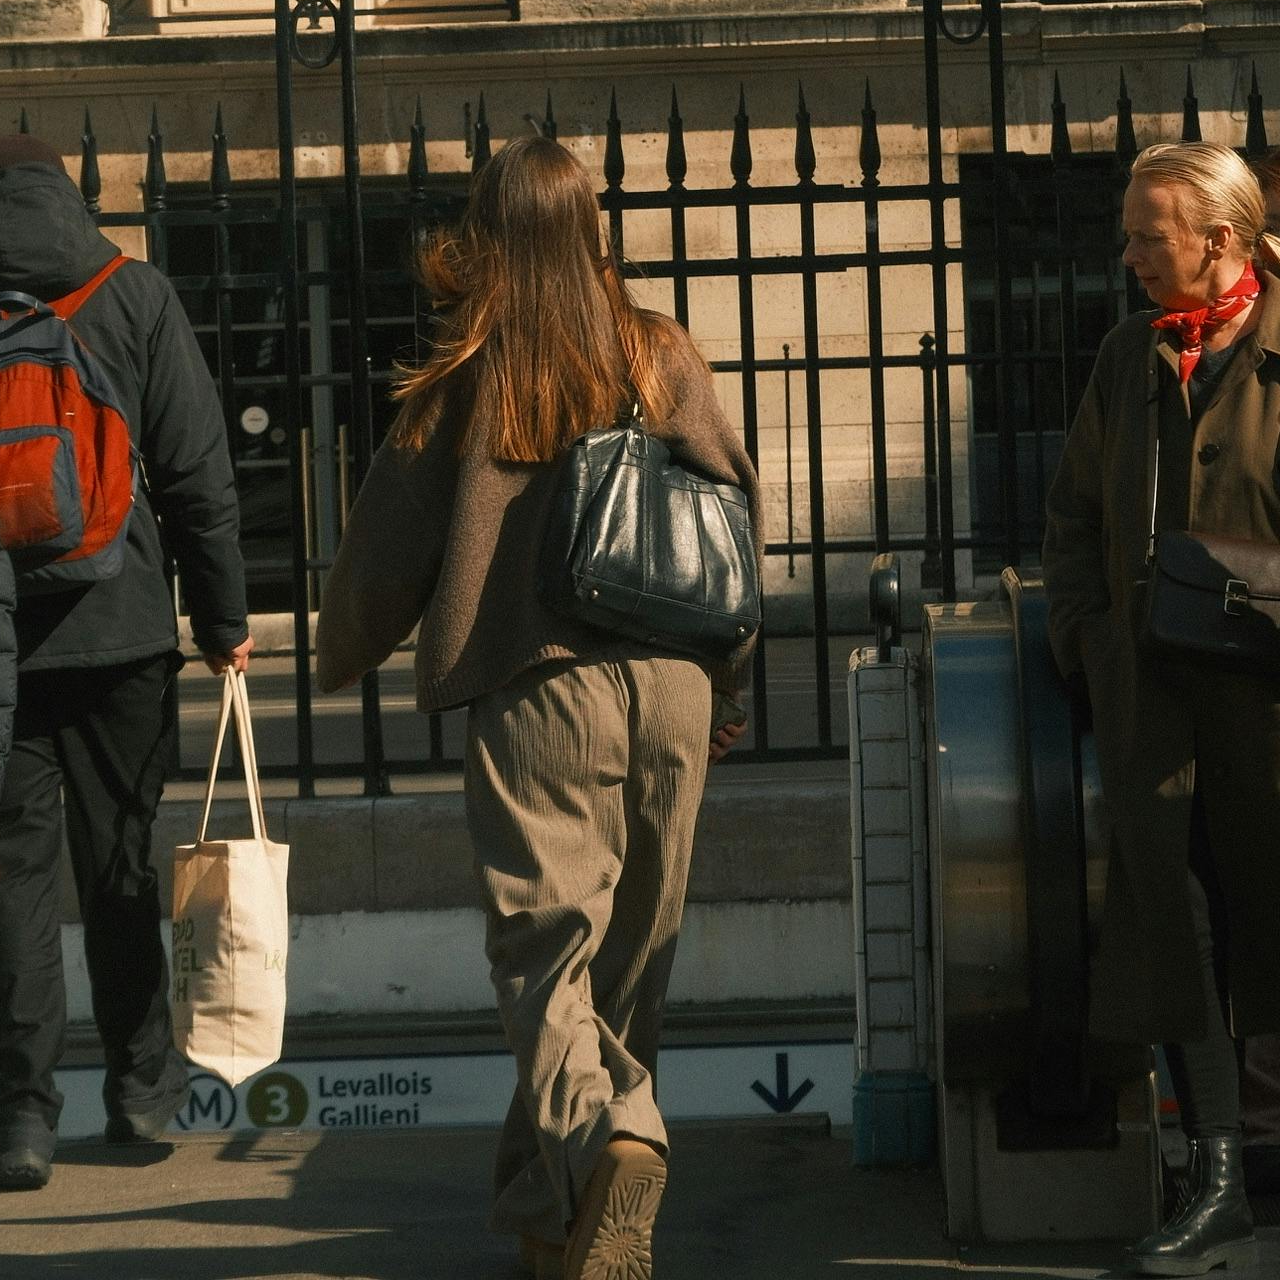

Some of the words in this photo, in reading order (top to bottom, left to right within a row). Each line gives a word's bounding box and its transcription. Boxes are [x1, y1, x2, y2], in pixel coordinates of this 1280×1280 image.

[188, 1087, 222, 1123] M
[266, 1085, 290, 1123] 3
[319, 1072, 433, 1098] Levallois
[320, 1103, 420, 1126] Gallieni
